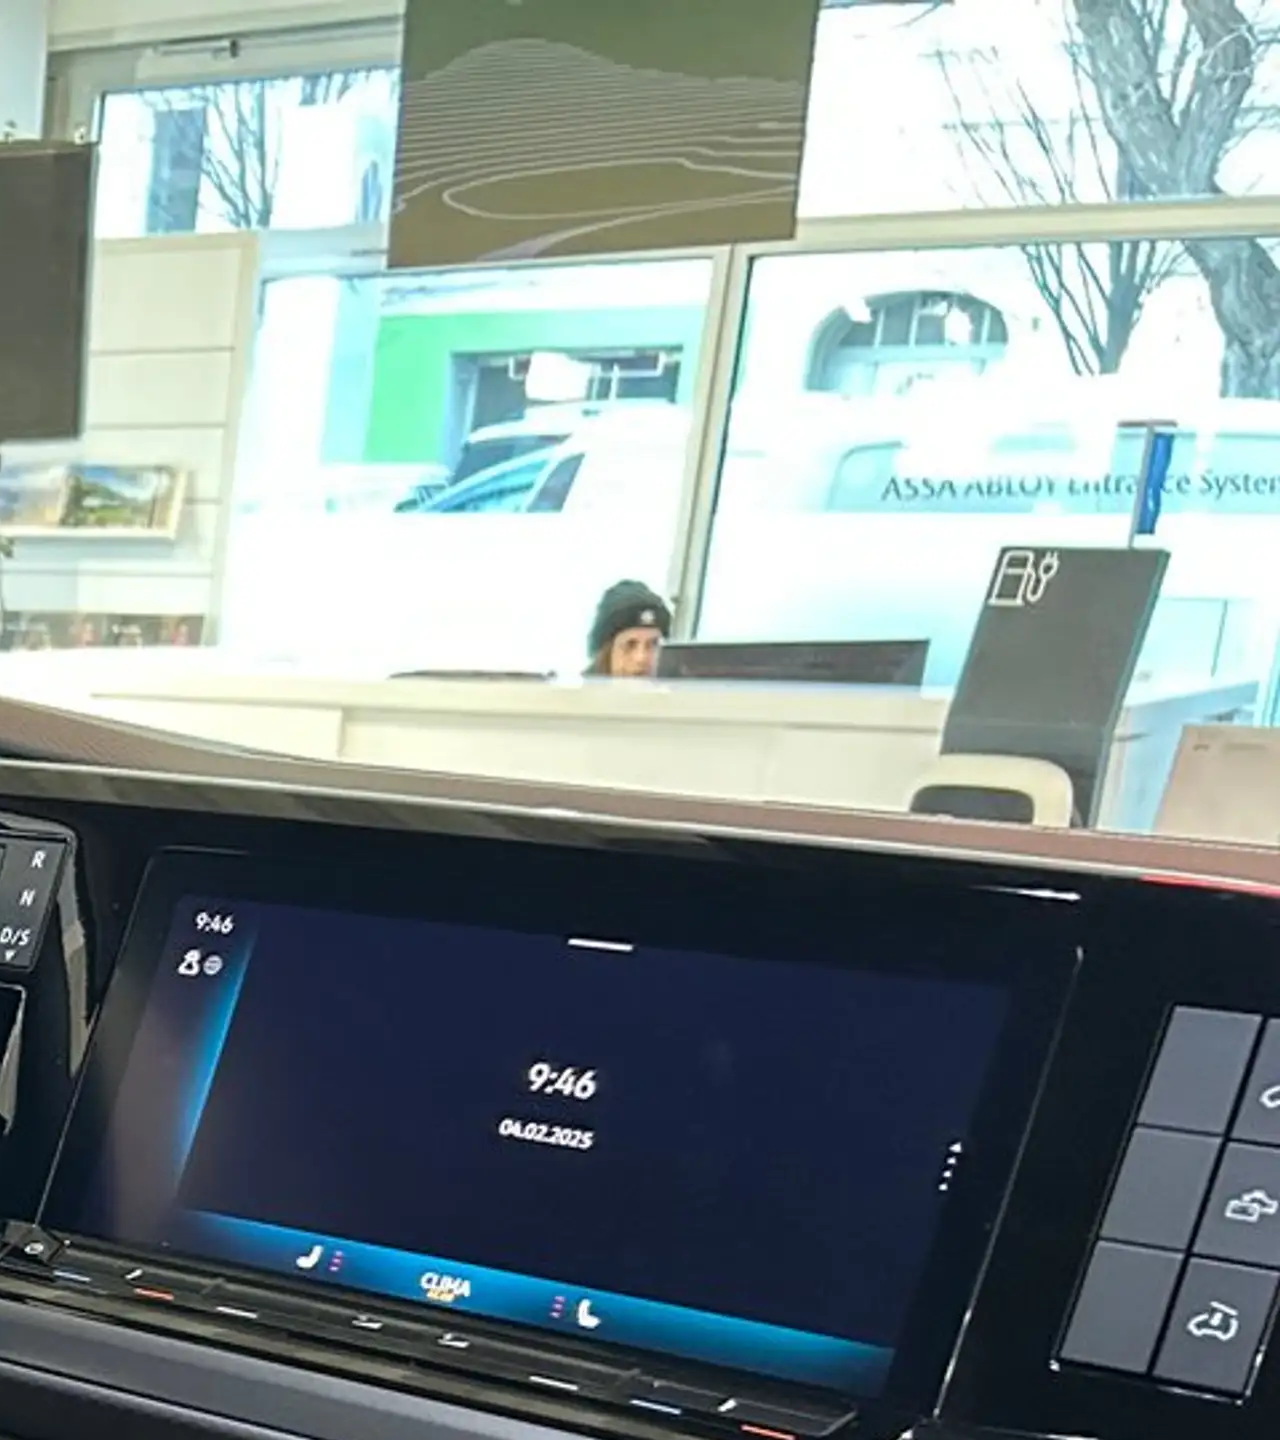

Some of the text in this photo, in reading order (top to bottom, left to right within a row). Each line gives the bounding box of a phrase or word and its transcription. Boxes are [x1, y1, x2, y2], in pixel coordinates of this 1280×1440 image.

[880, 475, 957, 501] ASSA
[963, 474, 1055, 498] ABLOY
[30, 850, 46, 869] R
[20, 889, 36, 907] N
[196, 911, 234, 935] 9:46
[0, 927, 32, 946] D/S
[528, 1062, 598, 1100] 9:46
[498, 1117, 595, 1150] 04.02.2025
